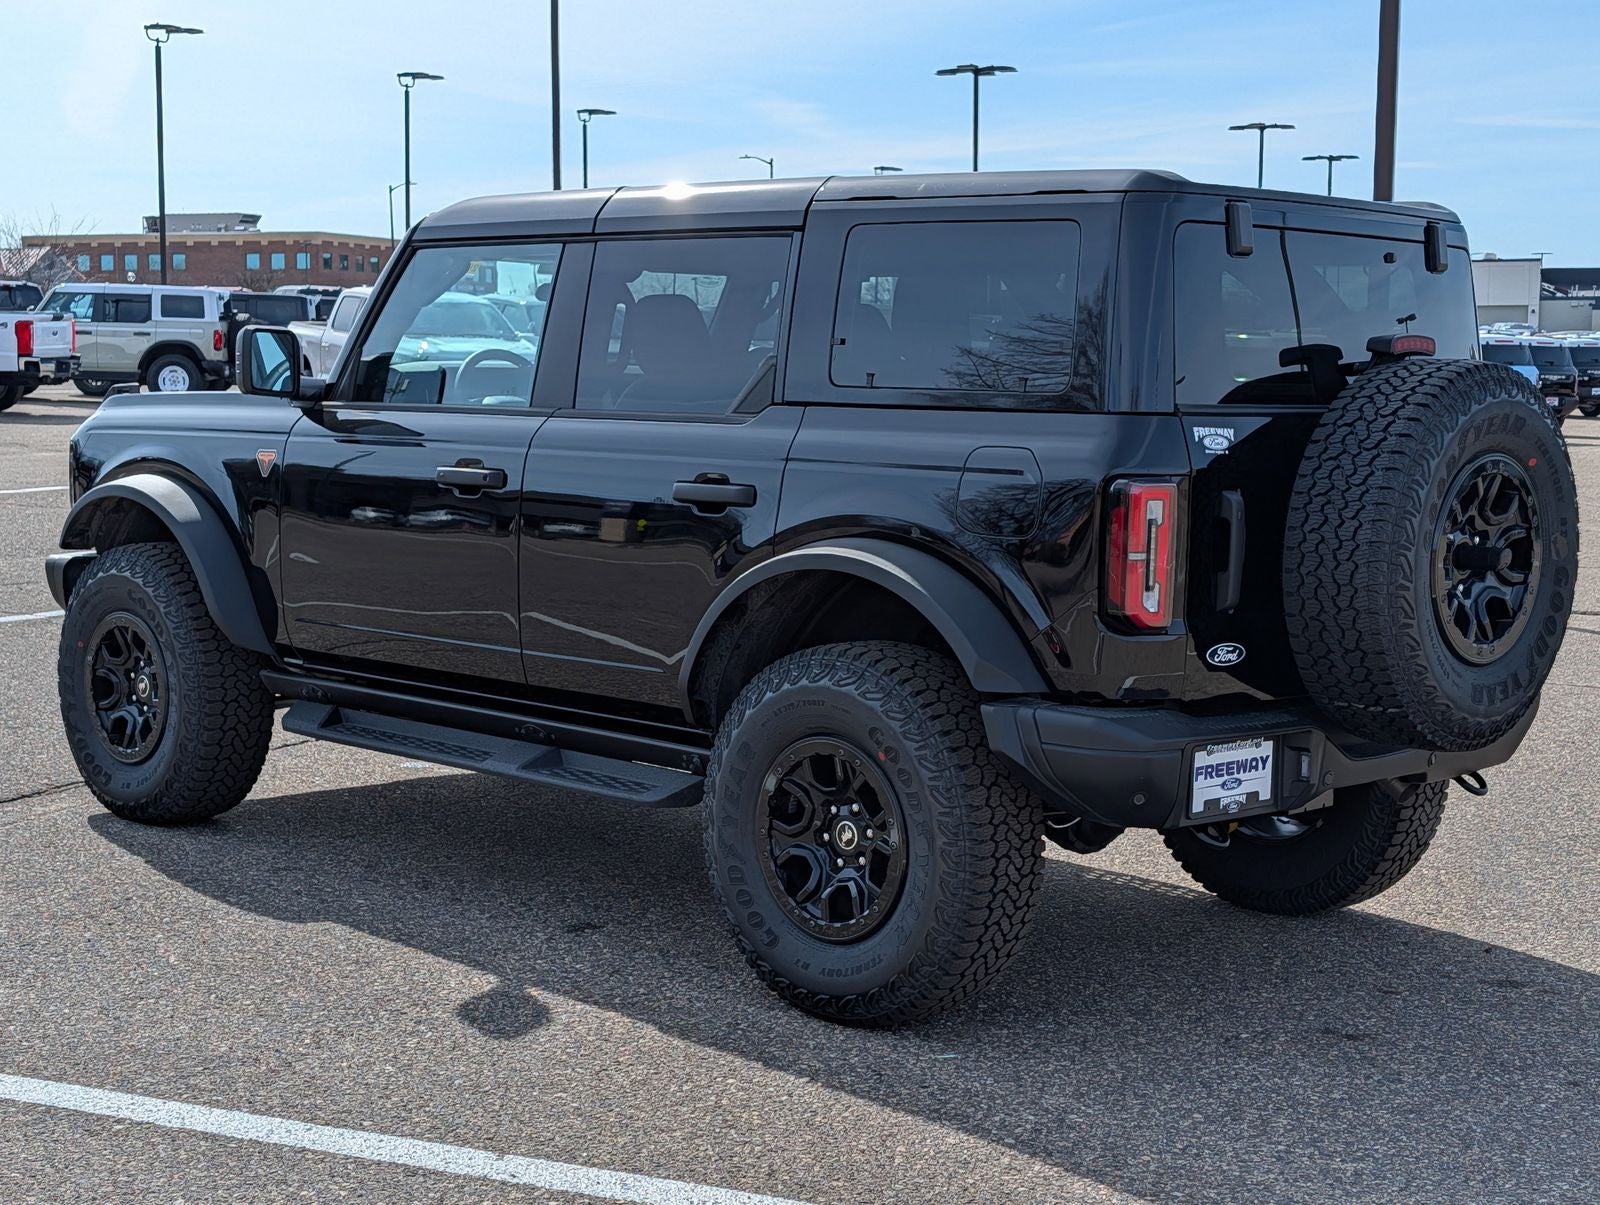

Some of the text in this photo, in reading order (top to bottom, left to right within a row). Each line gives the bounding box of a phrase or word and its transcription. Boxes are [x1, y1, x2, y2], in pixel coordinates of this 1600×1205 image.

[1193, 426, 1235, 442] FREEWAY
[1214, 646, 1239, 662] Ford
[1195, 755, 1270, 782] FREEWAY
[1220, 793, 1247, 810] FREEWAY
[792, 952, 887, 978] TERRITORY RT
